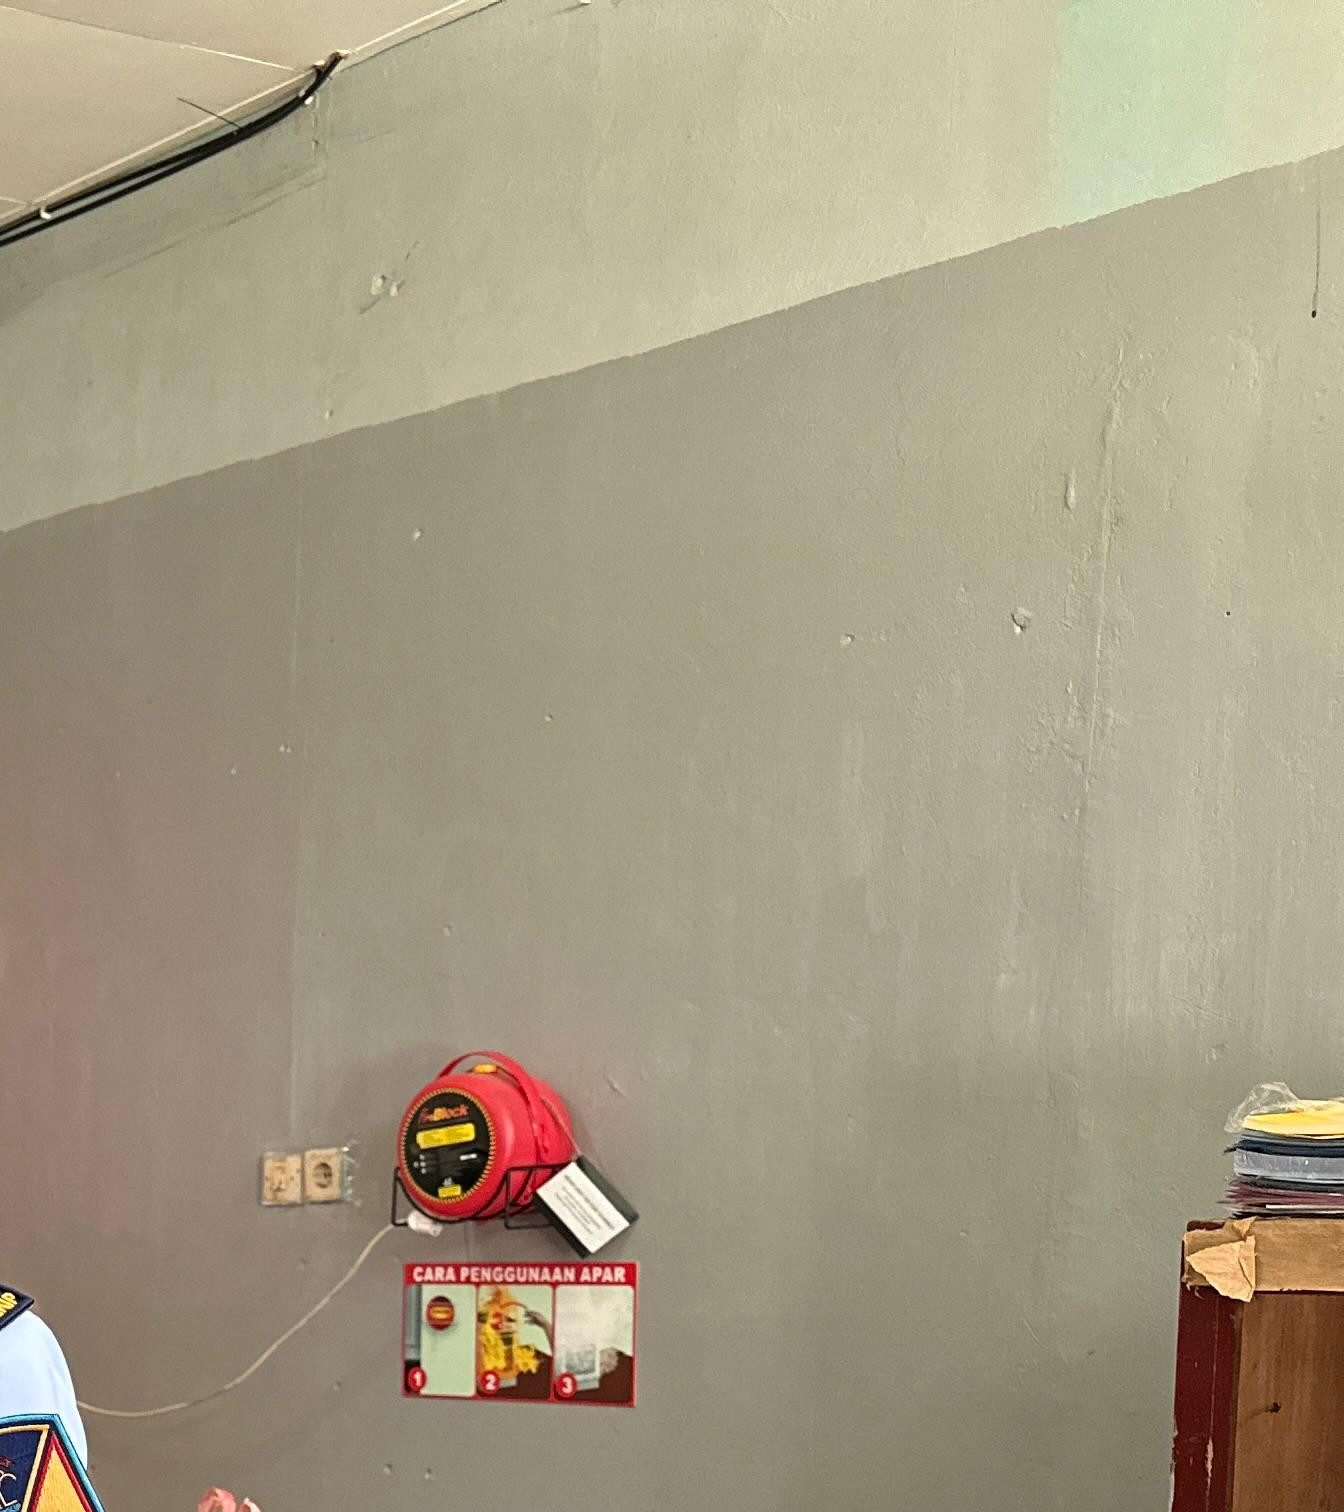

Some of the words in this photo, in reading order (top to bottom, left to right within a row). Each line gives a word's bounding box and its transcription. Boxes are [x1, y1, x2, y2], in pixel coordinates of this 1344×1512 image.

[413, 1266, 456, 1282] CARA
[460, 1267, 576, 1283] PENGGUNAAN
[580, 1267, 626, 1283] APAR
